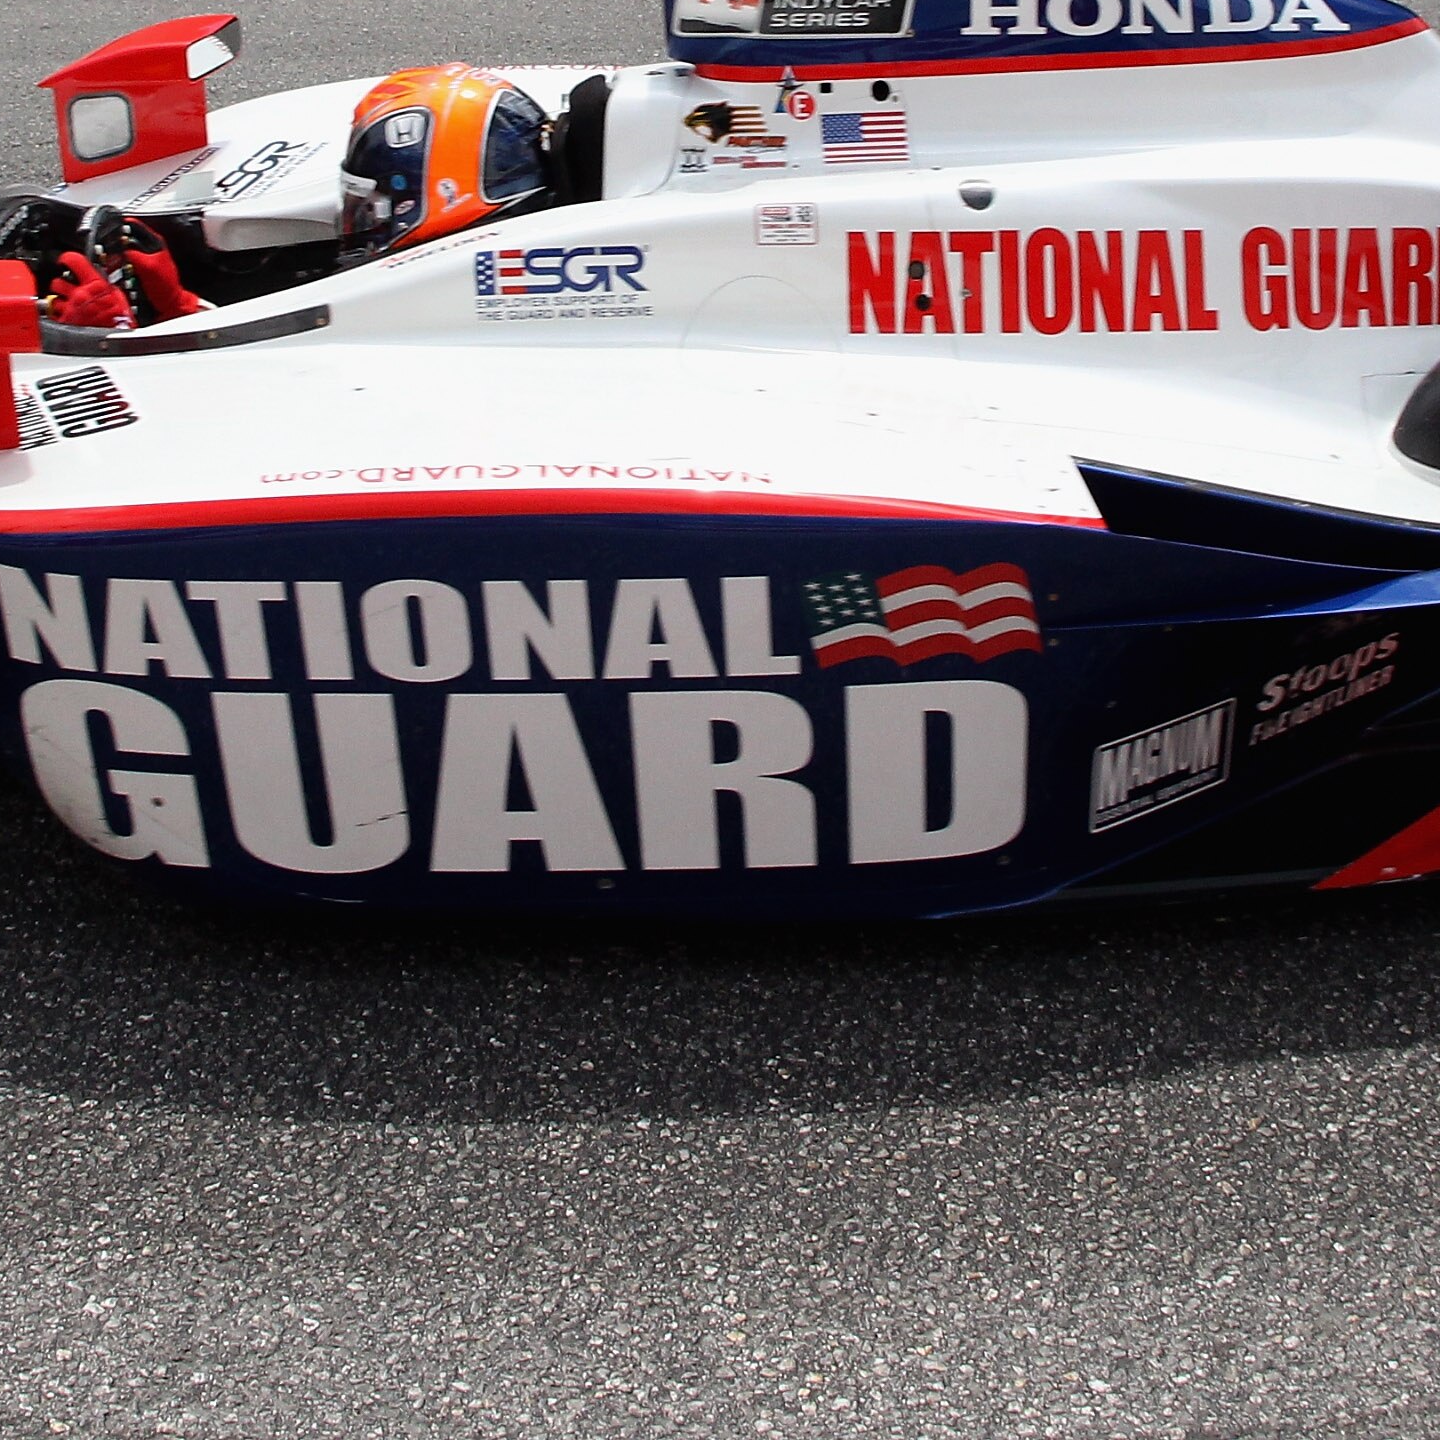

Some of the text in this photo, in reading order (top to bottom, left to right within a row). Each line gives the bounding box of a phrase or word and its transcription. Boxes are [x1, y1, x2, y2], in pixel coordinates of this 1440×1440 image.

[770, 12, 870, 28] SERIES
[477, 306, 654, 321] THE GUARD AND RESERVE
[555, 295, 615, 307] SUPPORT
[620, 294, 639, 305] OF
[846, 227, 1220, 335] NATIONAL
[36, 365, 140, 439] GUARD
[261, 463, 773, 484] NATIONALGUARD.com
[1256, 632, 1400, 711] Stoops
[22, 678, 1028, 874] GUARD
[1095, 707, 1224, 811] MAGNUM
